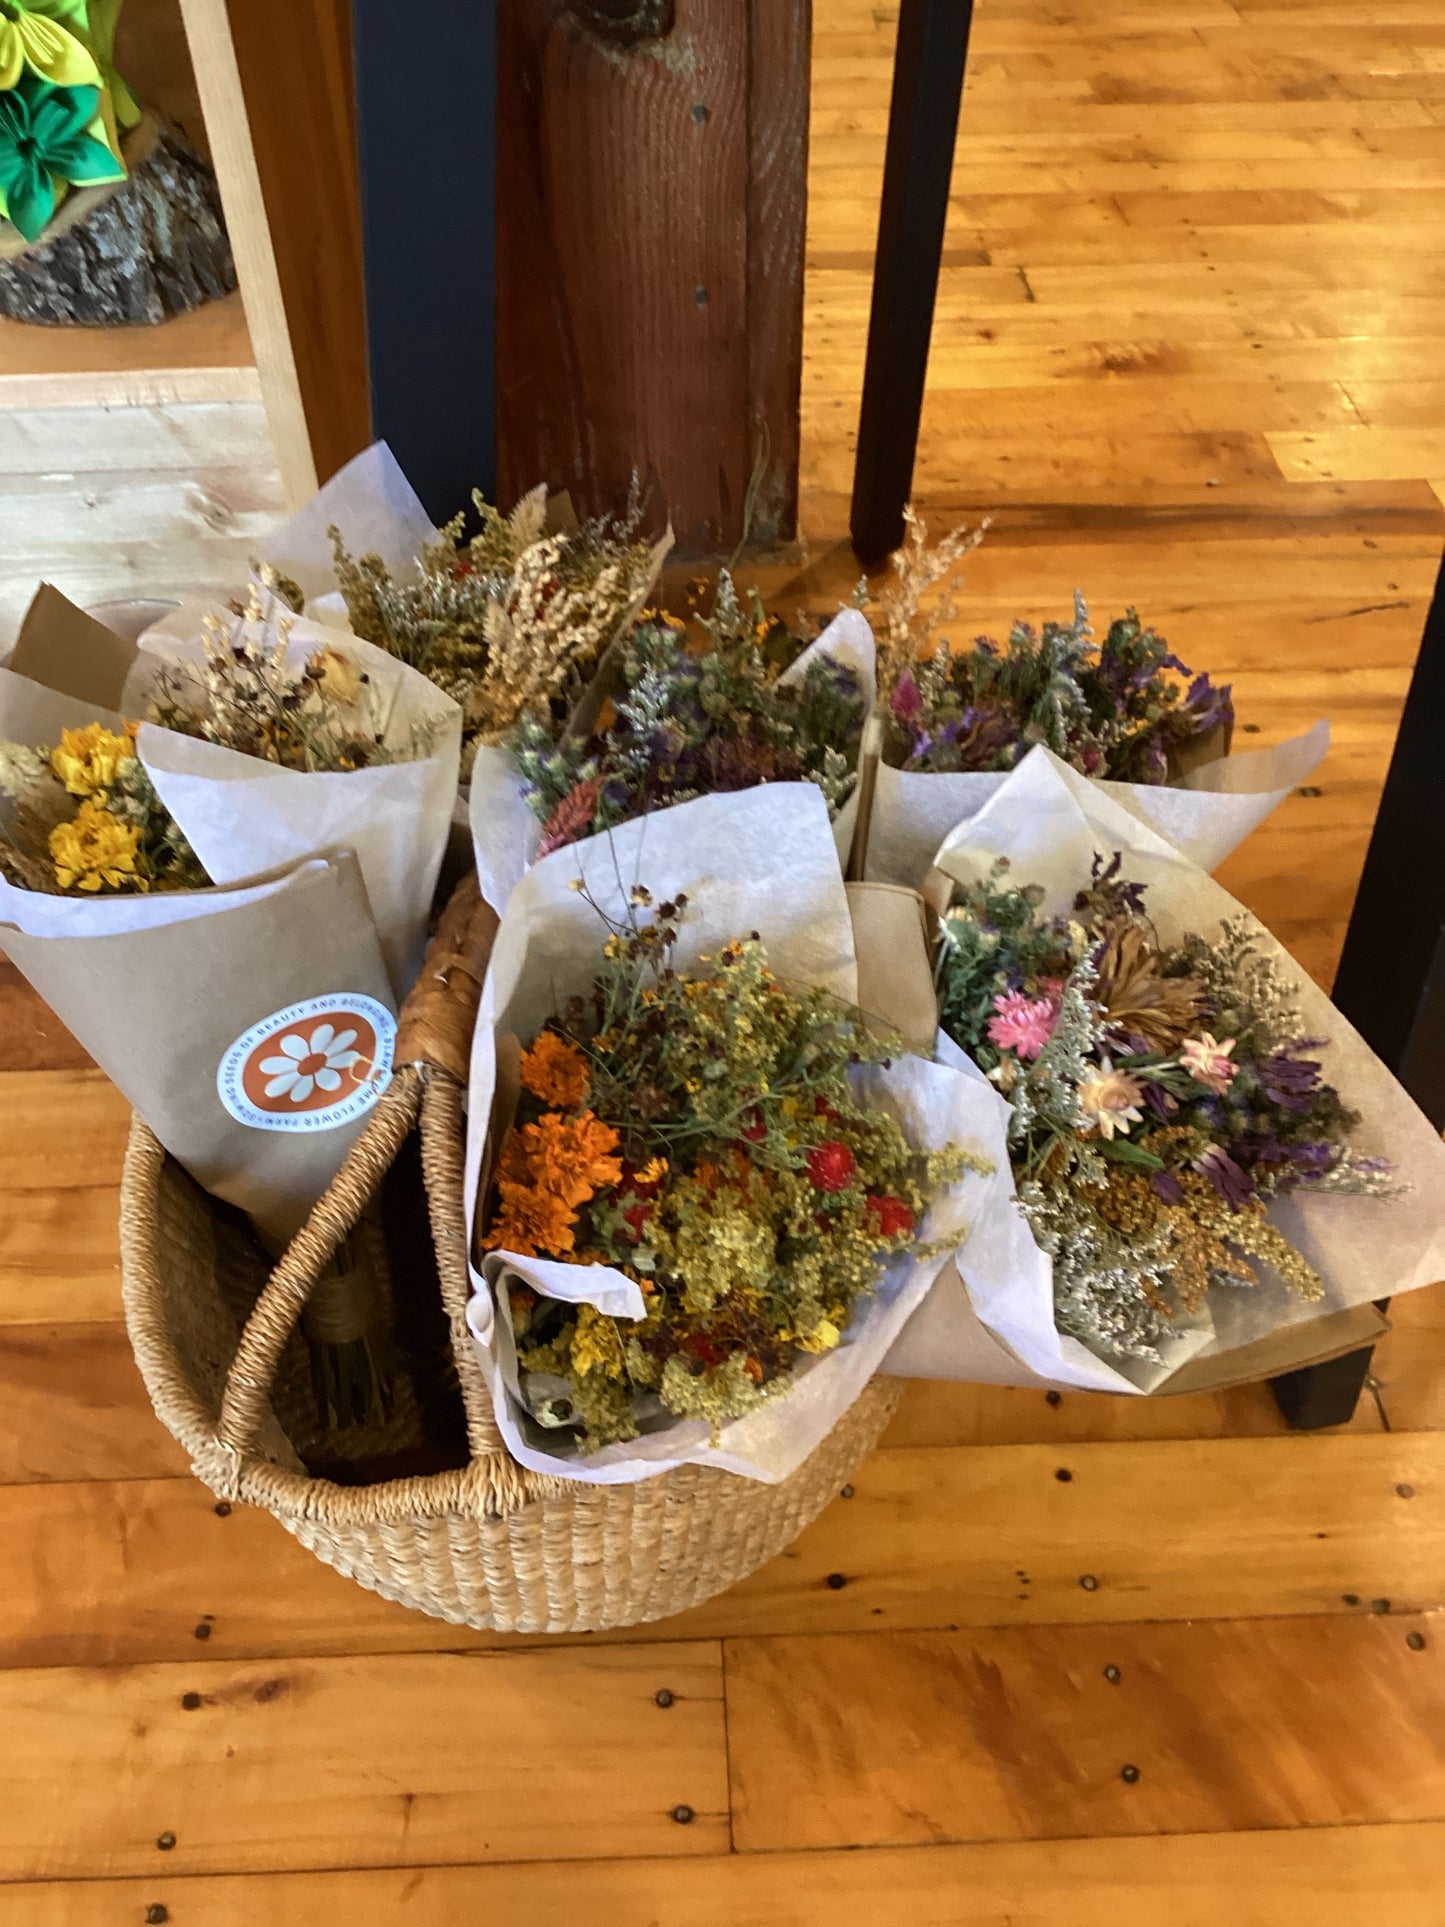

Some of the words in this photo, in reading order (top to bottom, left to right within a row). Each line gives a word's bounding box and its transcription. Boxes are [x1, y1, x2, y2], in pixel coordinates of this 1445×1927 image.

[224, 1051, 243, 1085] SEEDS
[239, 1036, 255, 1050] OF
[256, 1007, 306, 1035] BEAUTY
[311, 998, 338, 1012] AND
[265, 1117, 299, 1127] FARM
[303, 1105, 356, 1127] FLOWER
